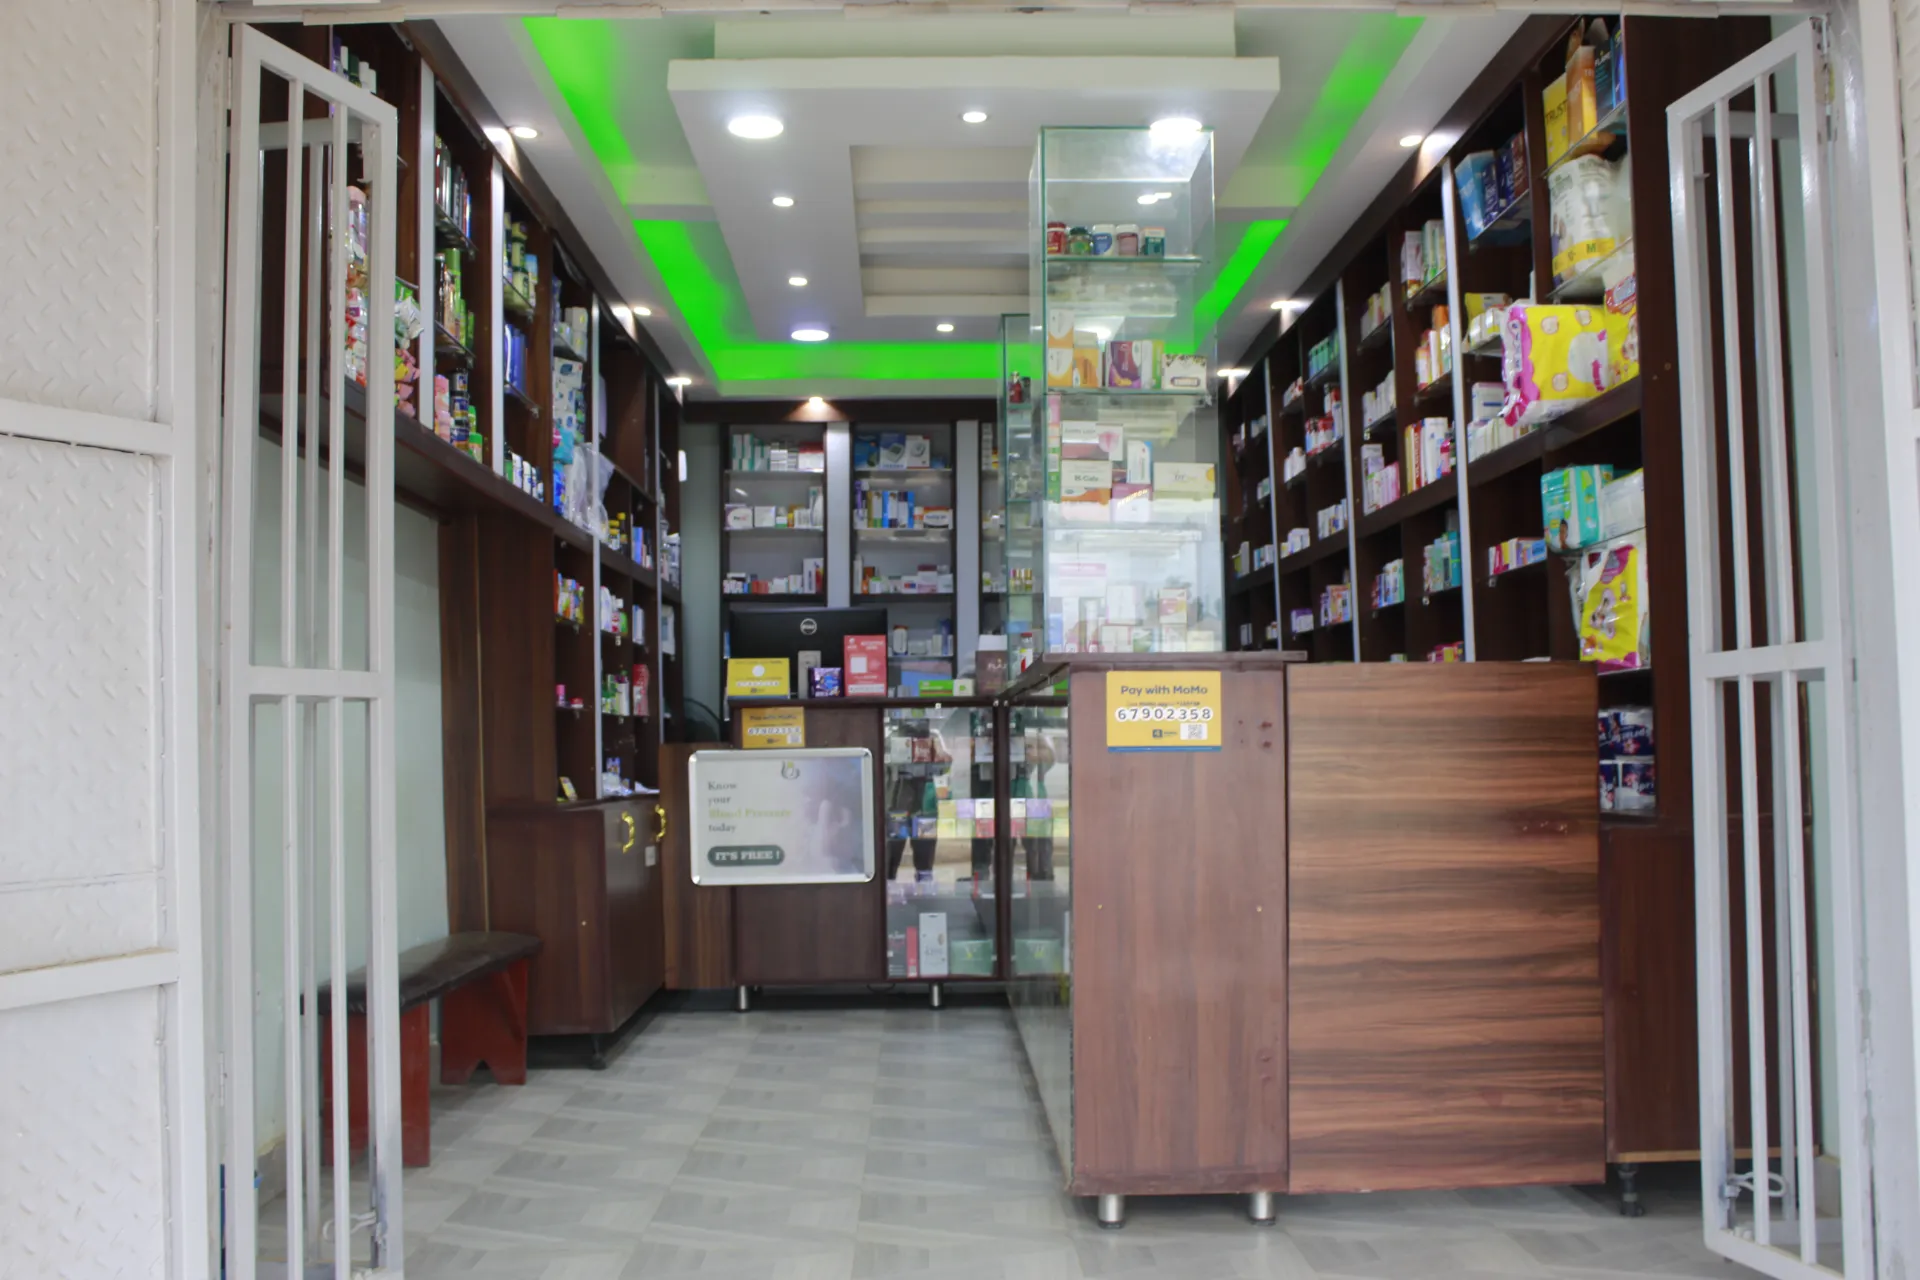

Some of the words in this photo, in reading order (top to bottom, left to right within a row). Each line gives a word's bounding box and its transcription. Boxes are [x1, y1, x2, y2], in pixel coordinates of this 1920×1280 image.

[1121, 685, 1142, 696] Pay
[1145, 685, 1170, 695] with
[1173, 685, 1208, 695] MoMo
[1117, 708, 1211, 720] 67902358
[708, 781, 737, 791] Know
[708, 796, 731, 806] your
[708, 823, 736, 833] today
[715, 851, 738, 861] IT'S
[740, 850, 774, 860] FREE
